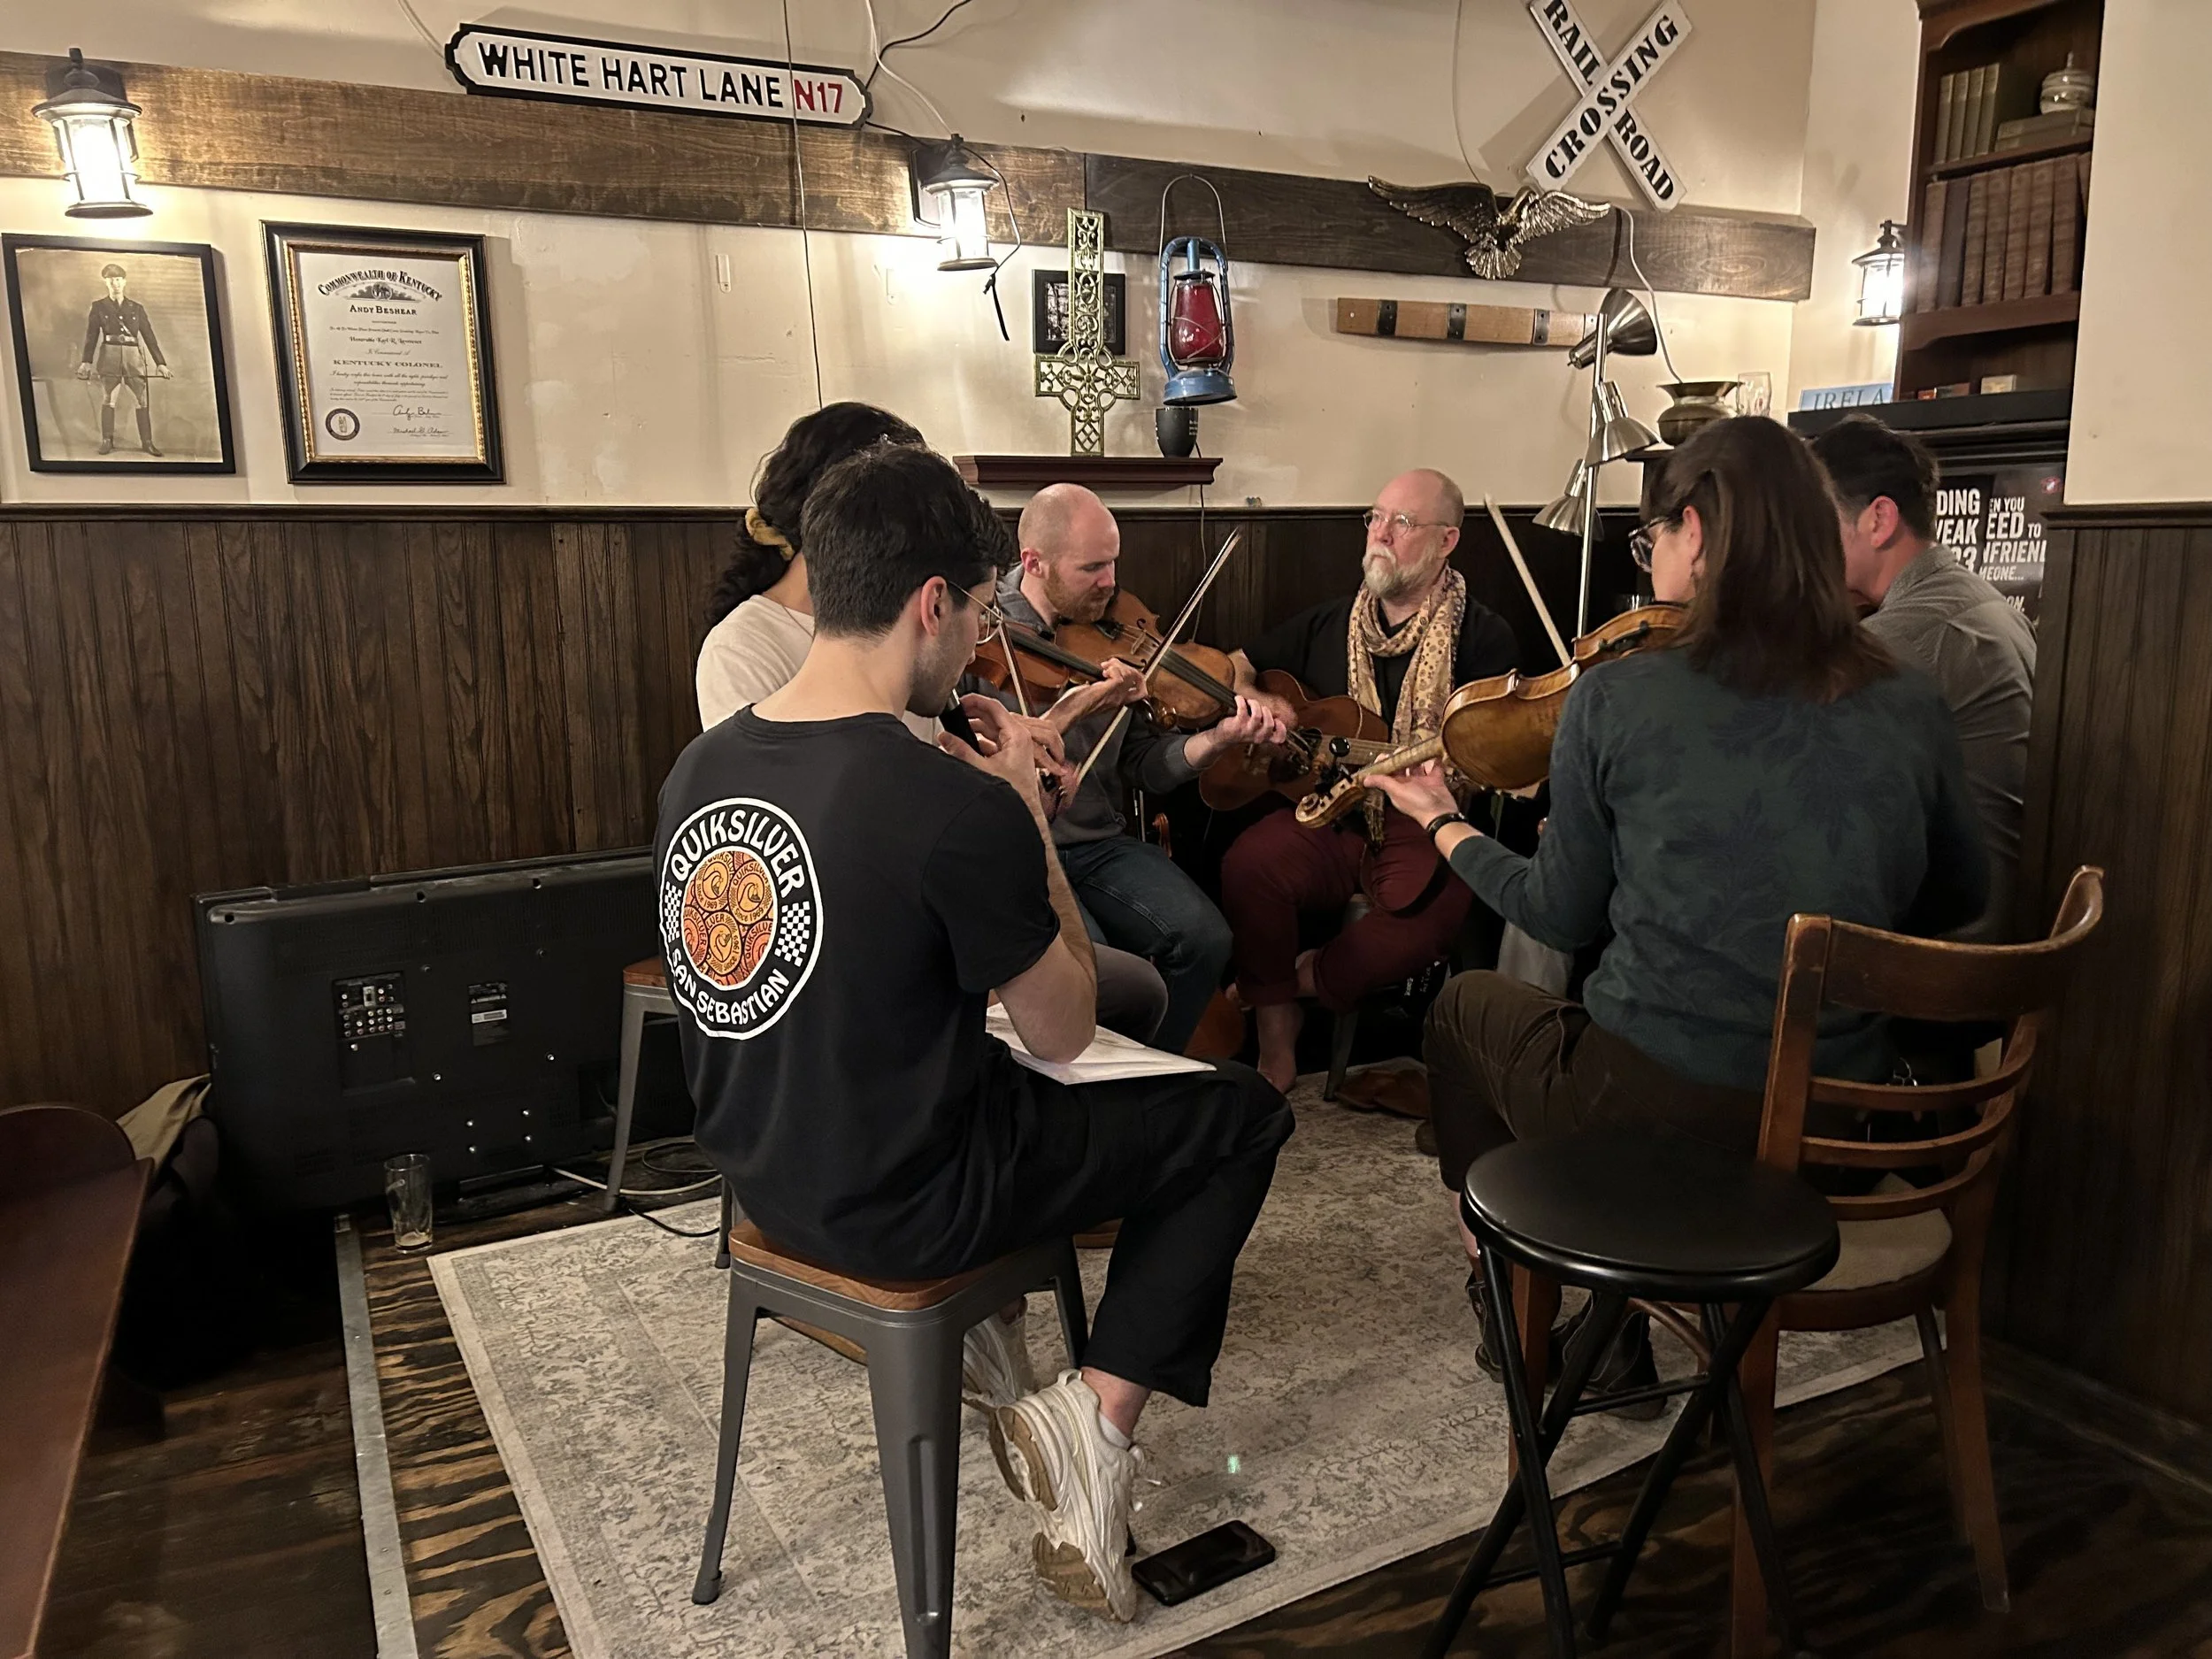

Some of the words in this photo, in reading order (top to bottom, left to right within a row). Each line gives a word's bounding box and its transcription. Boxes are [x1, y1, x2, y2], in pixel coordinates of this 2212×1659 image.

[478, 42, 589, 87] WHITE
[601, 56, 687, 99] HART
[699, 68, 785, 109] LANE
[792, 78, 843, 114] N17
[1543, 0, 1601, 86] RAIL
[1614, 109, 1674, 201] ROAD
[1545, 14, 1679, 180] CROSSING
[318, 269, 387, 296] COMMONWEALTH
[399, 270, 443, 302] KENTUCKY
[349, 304, 374, 314] ANDY
[375, 305, 418, 316] BESHEAR
[2003, 496, 2025, 512] YOU
[2027, 522, 2042, 539] TO
[671, 809, 805, 899] QUIKSILVER
[672, 949, 698, 999] SAN
[695, 968, 790, 1025] SEBASTIAN
